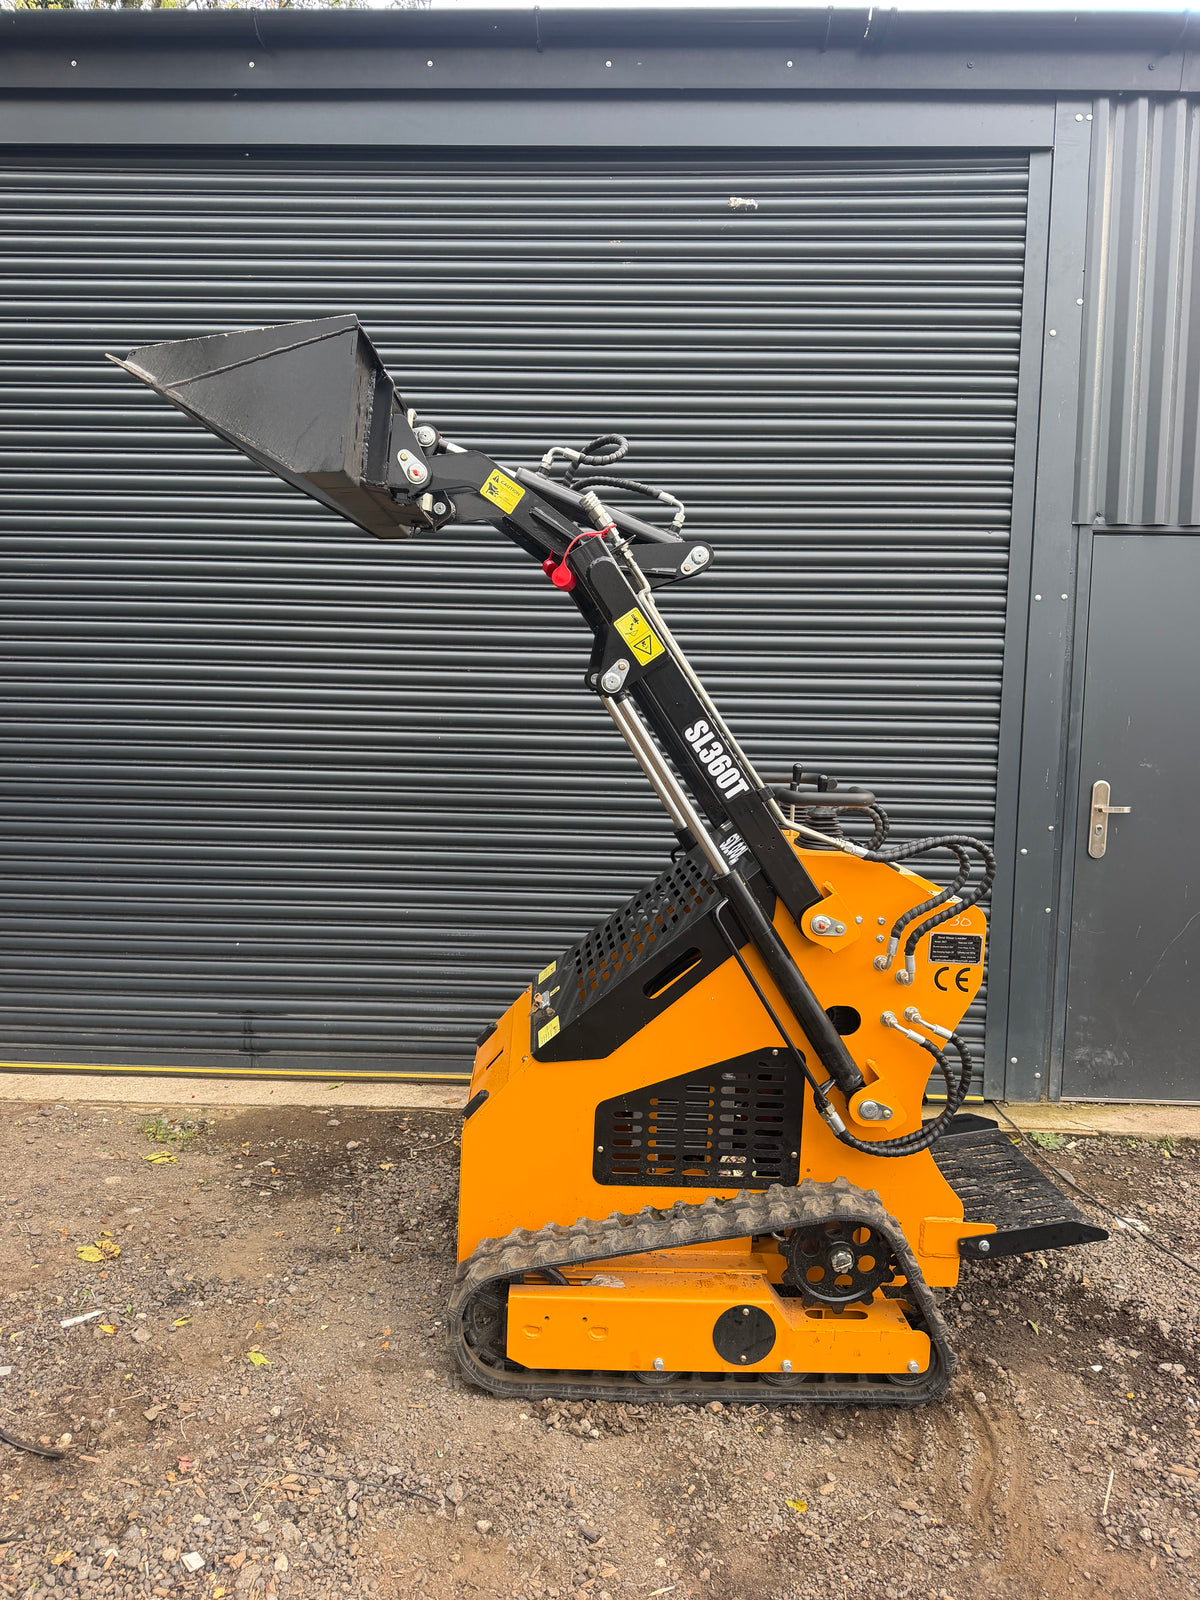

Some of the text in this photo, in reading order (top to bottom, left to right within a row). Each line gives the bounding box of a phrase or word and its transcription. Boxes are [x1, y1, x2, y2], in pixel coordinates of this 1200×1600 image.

[500, 480, 521, 496] CAUTION
[684, 719, 750, 800] SL360T
[934, 966, 971, 993] CE
